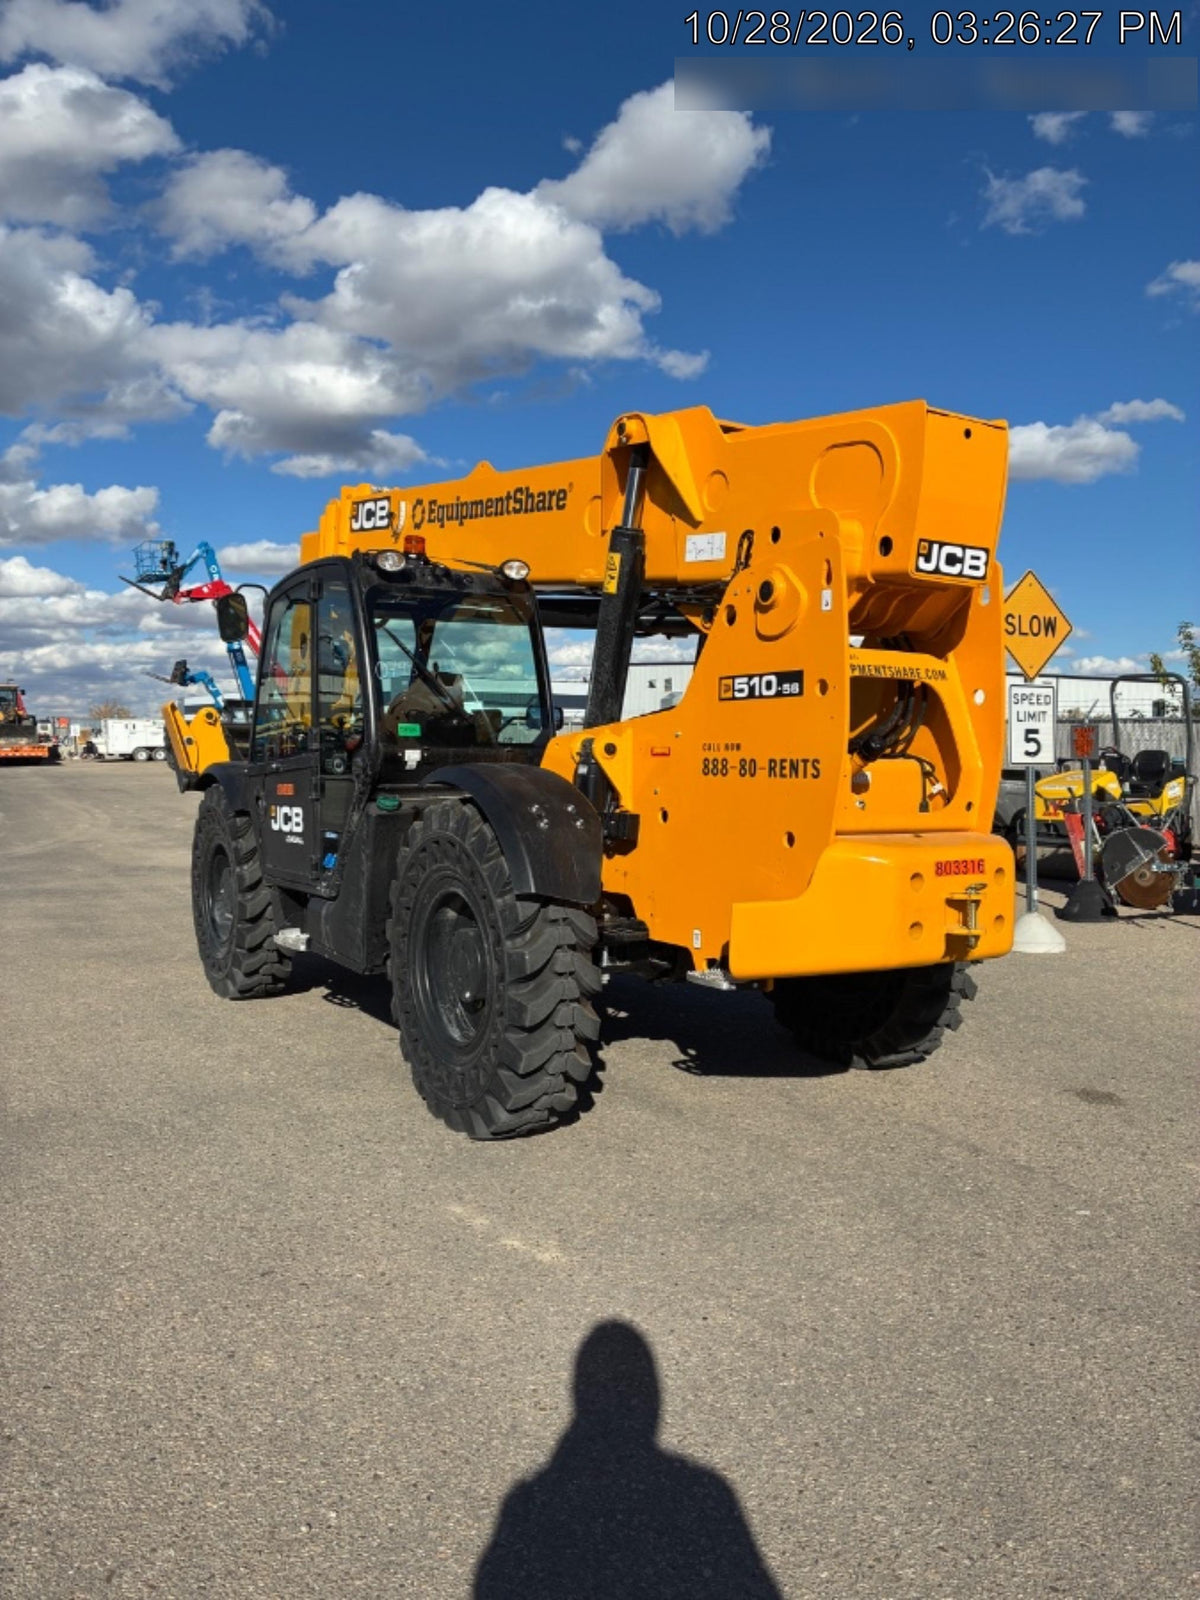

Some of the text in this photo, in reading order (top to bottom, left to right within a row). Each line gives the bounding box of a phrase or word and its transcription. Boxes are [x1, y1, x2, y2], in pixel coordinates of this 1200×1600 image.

[351, 499, 389, 531] JCB
[427, 486, 567, 528] EquipmentShare
[917, 543, 987, 578] JCB
[1004, 613, 1057, 638] SLOW
[1012, 692, 1052, 706] SPEED
[1016, 710, 1048, 723] LIMIT
[702, 742, 721, 752] CALL
[1024, 728, 1042, 758] 5
[702, 757, 821, 779] 888-80-RENTS
[271, 805, 304, 833] JCB
[935, 858, 985, 877] 803316
